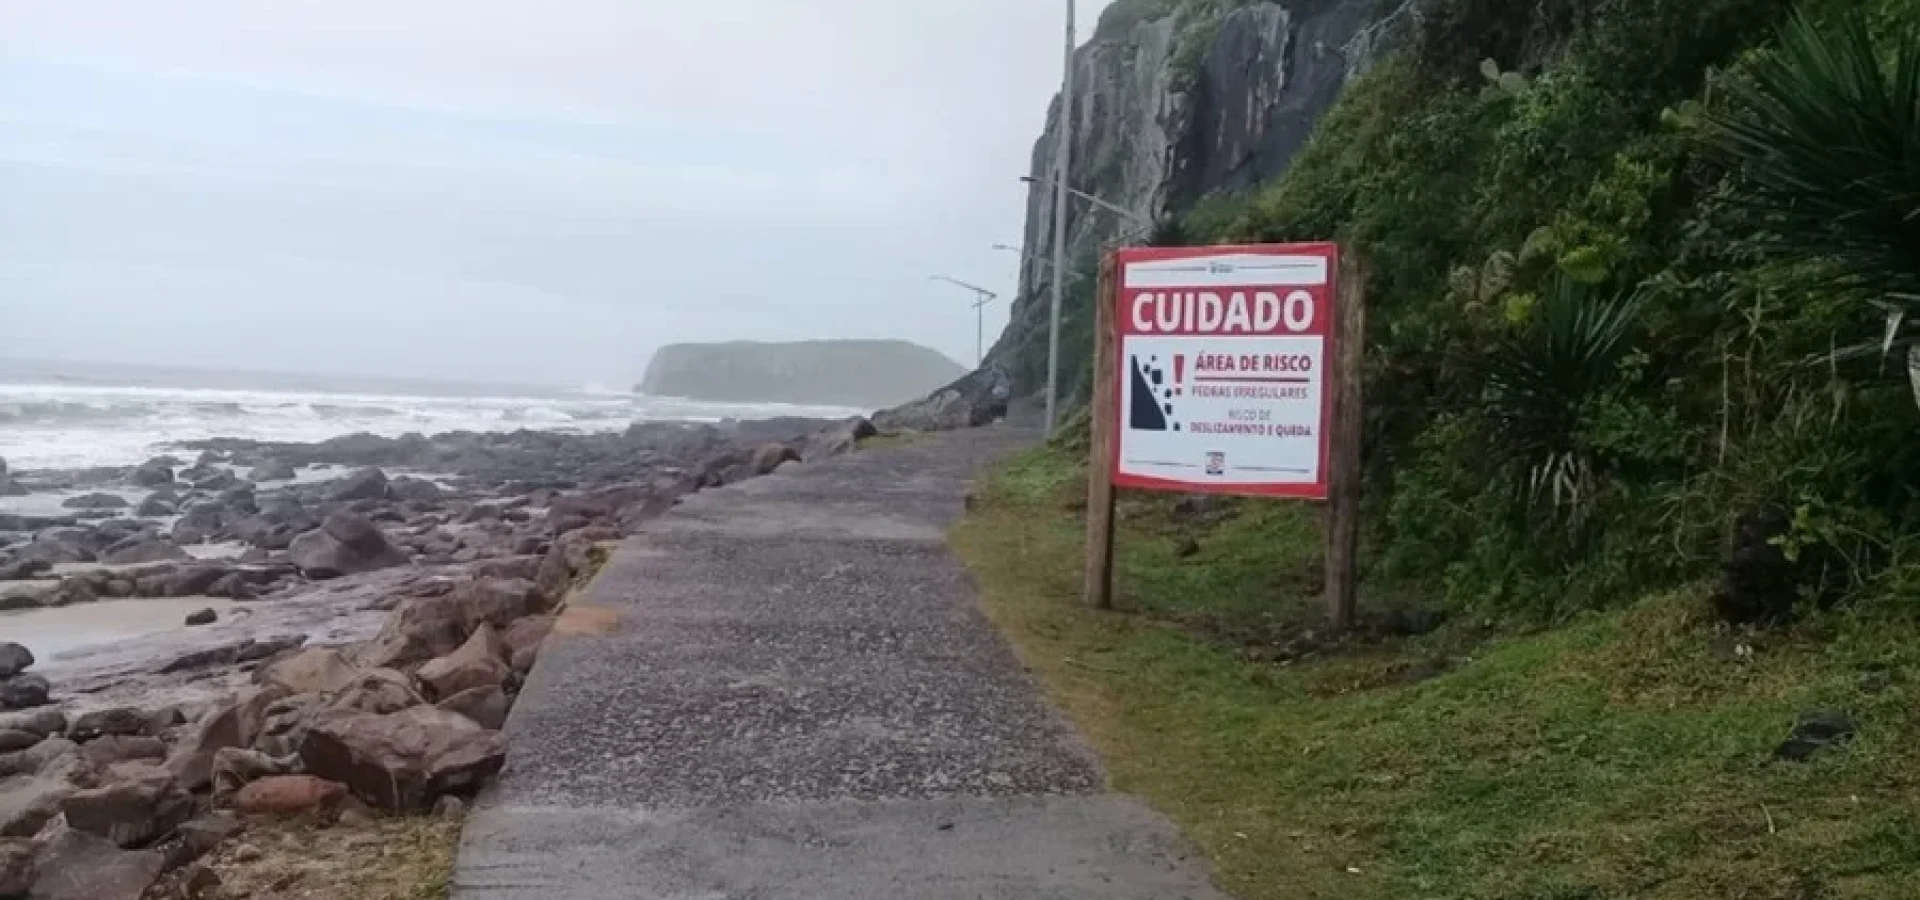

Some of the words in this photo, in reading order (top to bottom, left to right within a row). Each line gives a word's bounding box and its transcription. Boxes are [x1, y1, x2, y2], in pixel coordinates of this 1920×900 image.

[1132, 289, 1314, 332] CUIDADO
[1195, 350, 1235, 371] ÁREA
[1239, 354, 1259, 371] DE
[1263, 354, 1312, 372] RISCO
[1192, 386, 1231, 399] PEDRAS
[1234, 386, 1308, 400] IRREGULARES
[1190, 421, 1265, 435] DESLIZAMENTO
[1275, 424, 1311, 437] QUEDA
